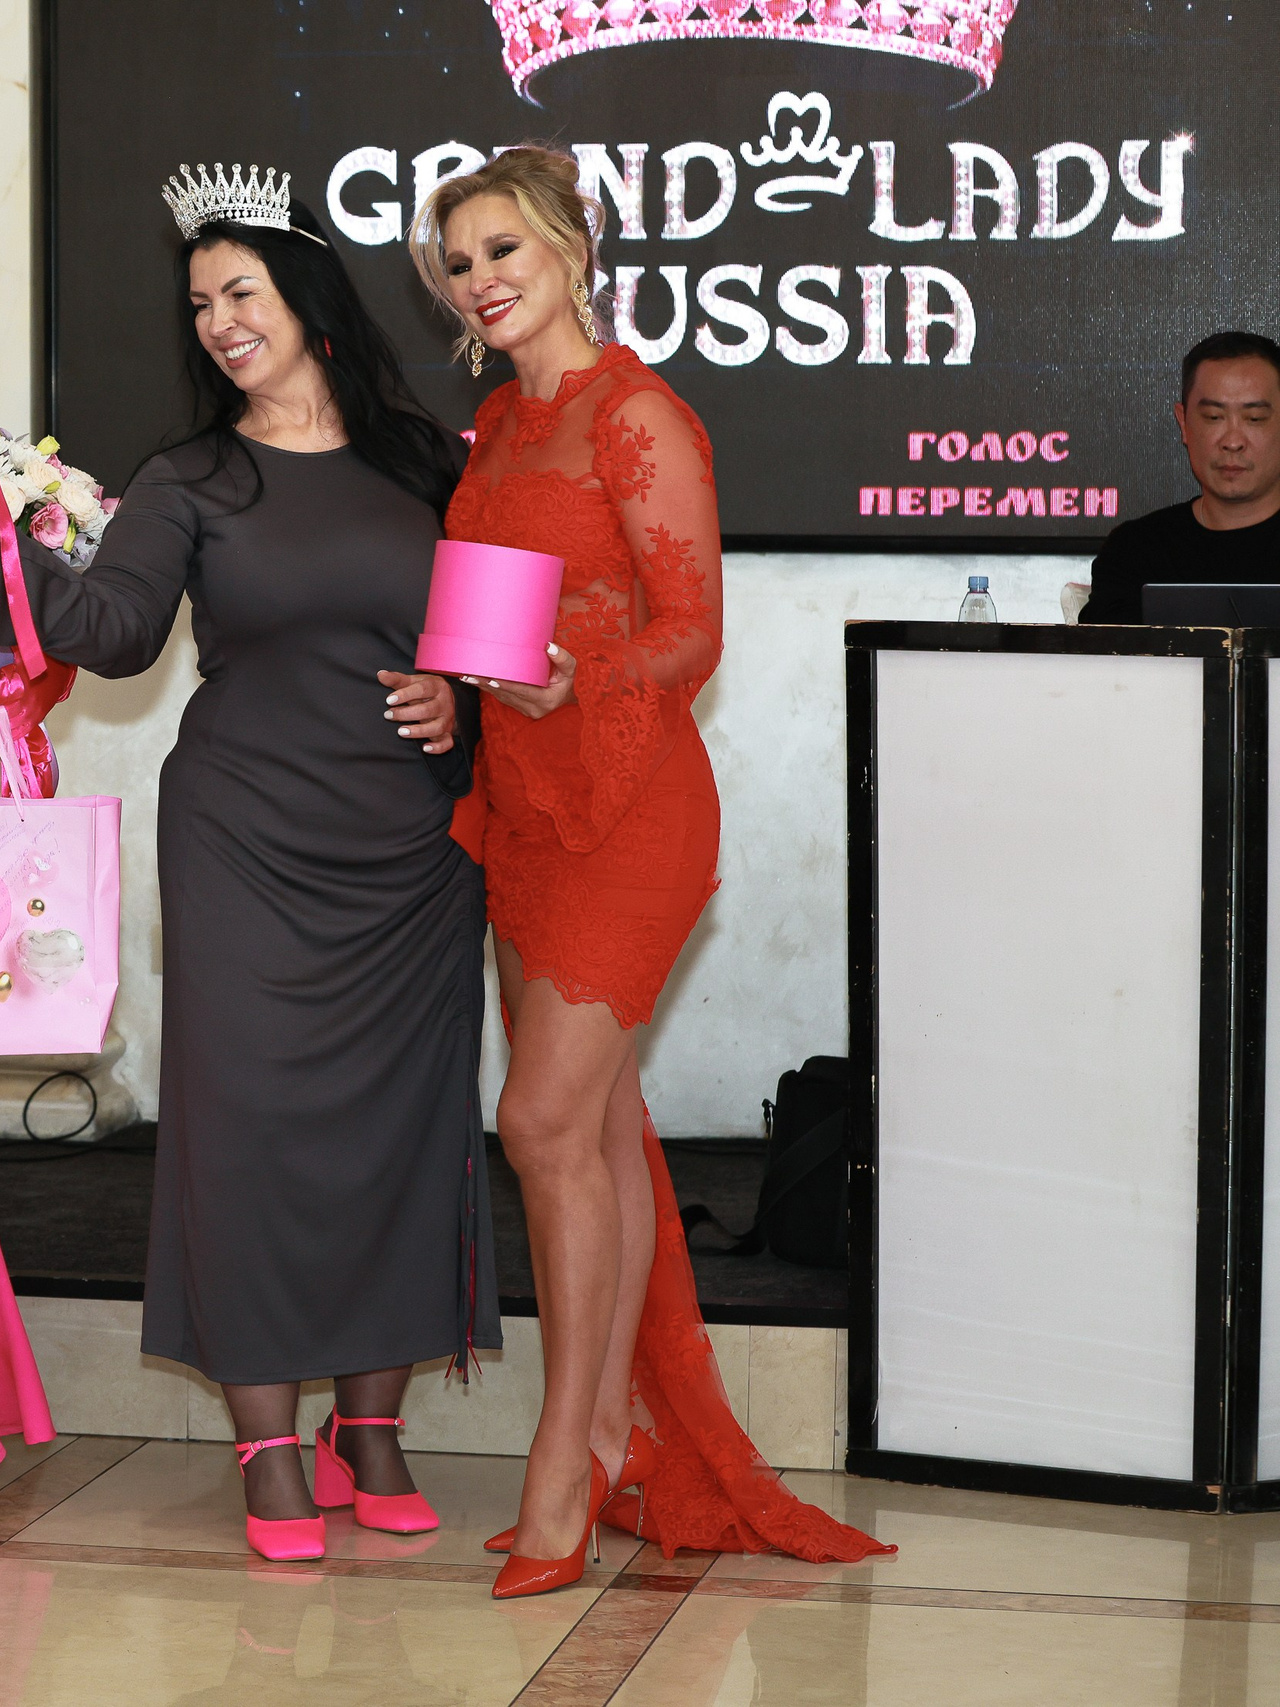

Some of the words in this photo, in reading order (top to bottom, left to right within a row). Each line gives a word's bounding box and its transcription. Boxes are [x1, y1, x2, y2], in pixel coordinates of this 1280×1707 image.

[326, 140, 737, 246] GRND
[868, 137, 1194, 243] LADY
[593, 263, 977, 366] USSIA
[907, 431, 1070, 462] ГОЛОС
[859, 486, 1119, 517] ПЕРЕМЕН
